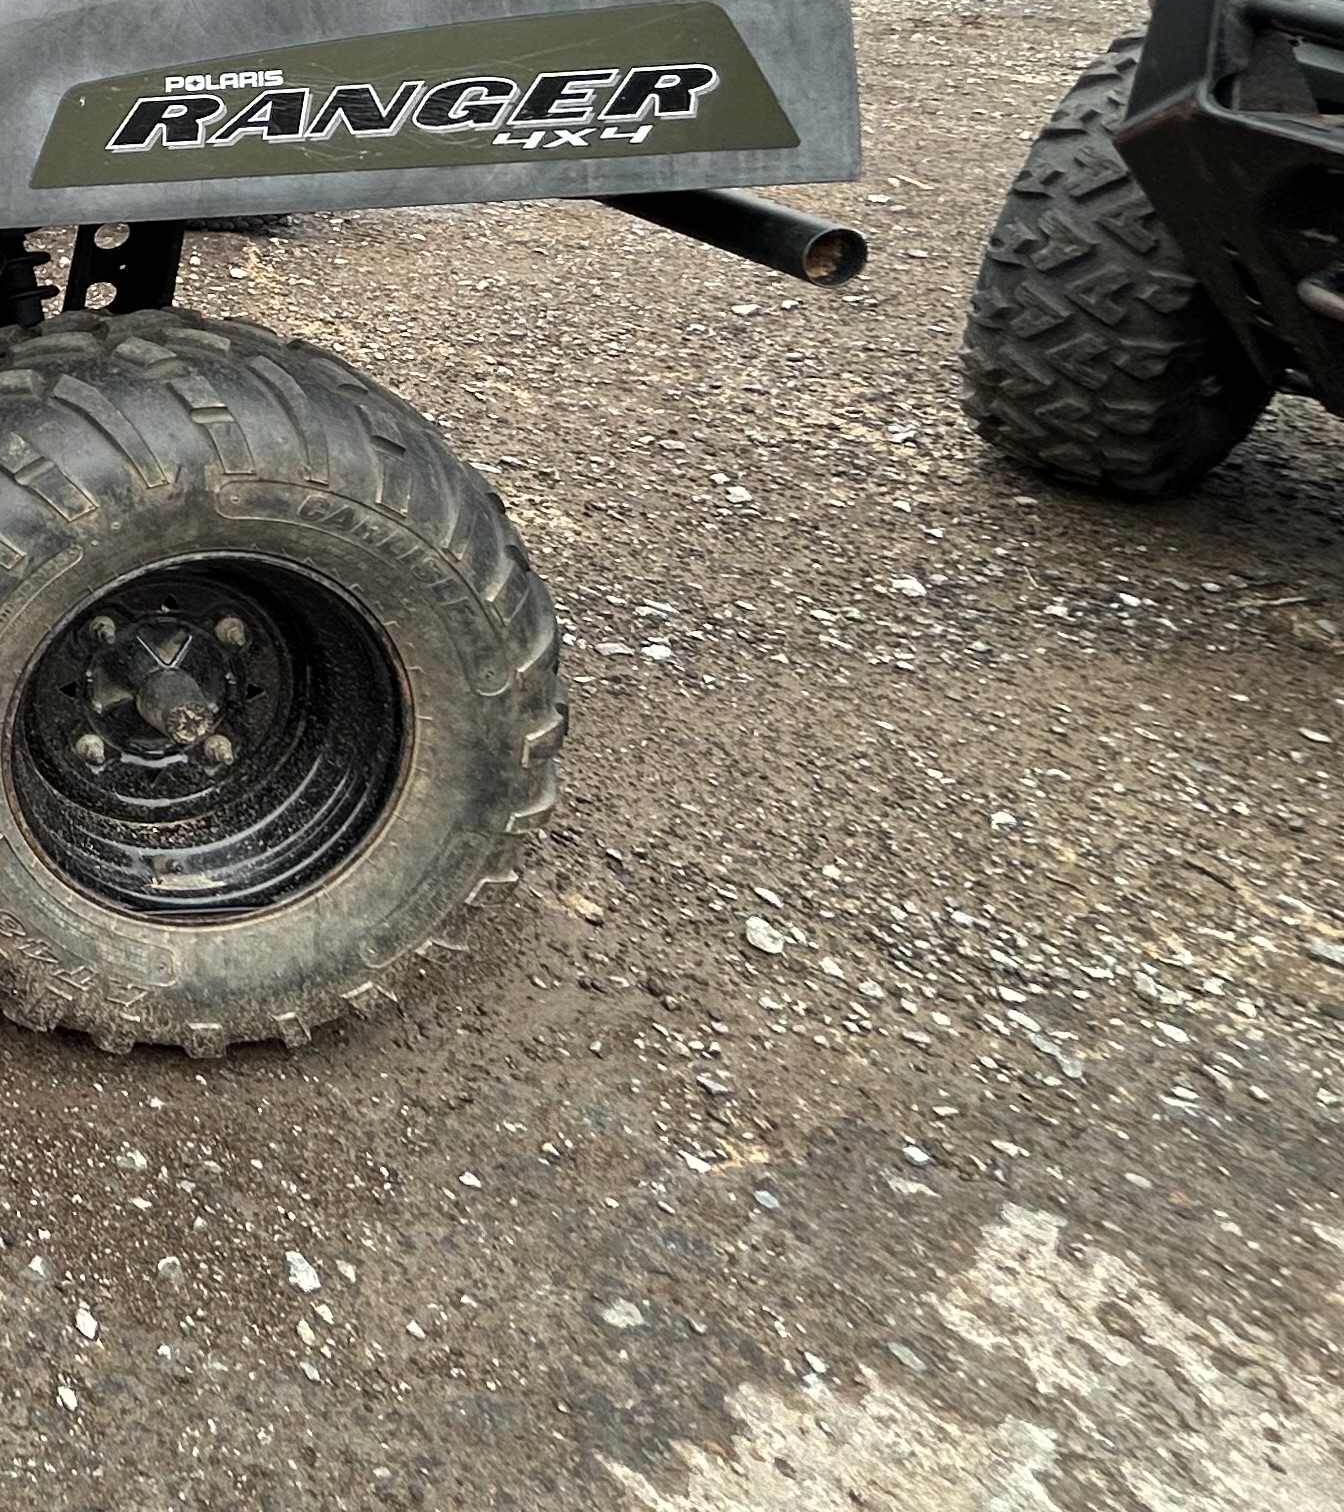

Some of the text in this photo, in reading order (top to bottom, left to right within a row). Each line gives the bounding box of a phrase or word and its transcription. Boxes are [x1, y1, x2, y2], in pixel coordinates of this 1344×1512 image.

[106, 63, 721, 153] RANGER
[164, 69, 284, 94] POLARIS
[297, 493, 478, 619] CARLISLE
